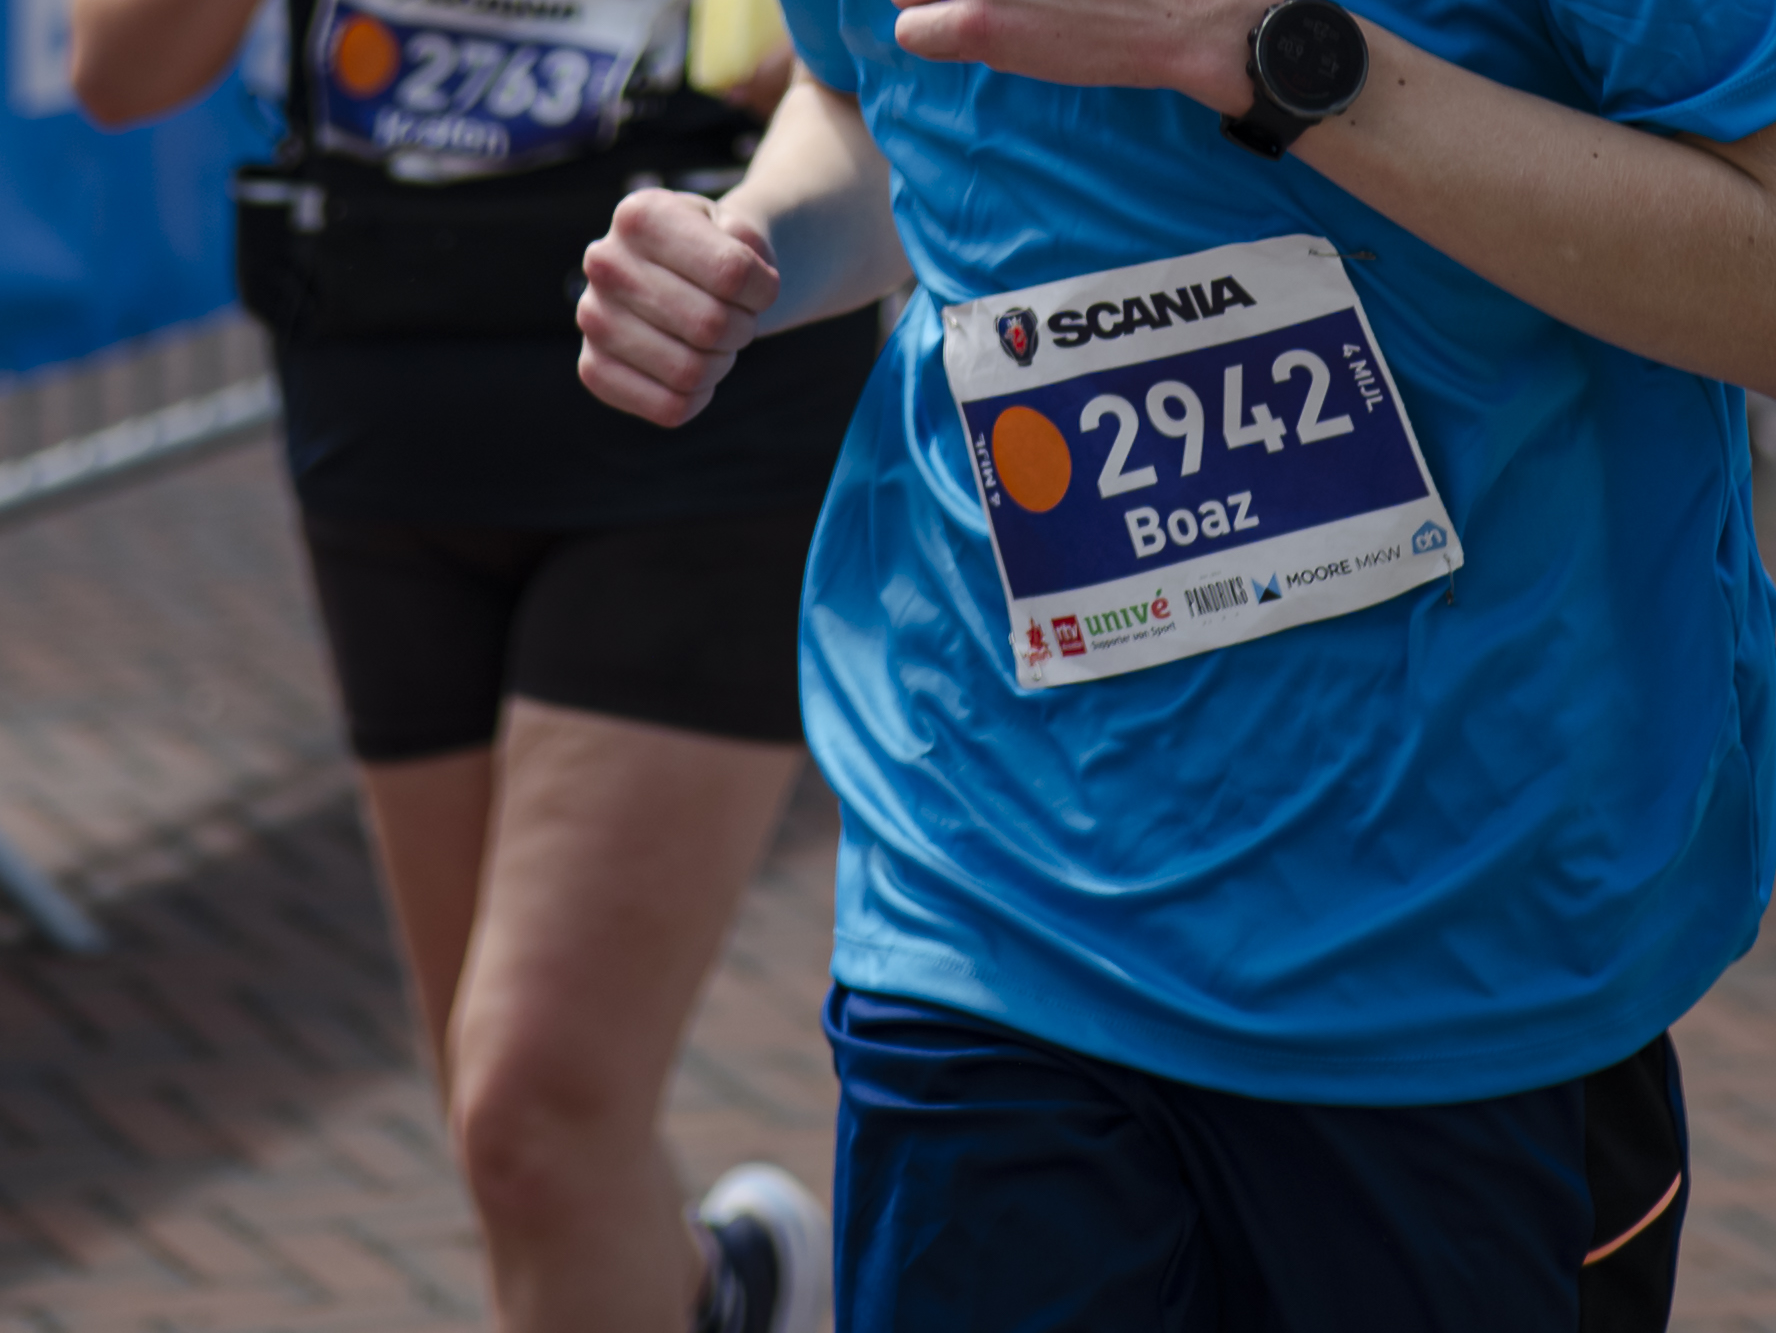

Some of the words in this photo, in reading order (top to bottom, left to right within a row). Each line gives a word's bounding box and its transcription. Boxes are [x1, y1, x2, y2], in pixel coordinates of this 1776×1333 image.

[399, 35, 588, 124] 2763
[1046, 275, 1257, 349] SCANIA
[1349, 359, 1384, 414] MIJL
[1078, 348, 1355, 499] 2942
[1124, 489, 1260, 560] Boaz
[1183, 575, 1250, 619] PANDRIKS
[1285, 558, 1353, 590] MOORE
[1083, 587, 1172, 637] univé
